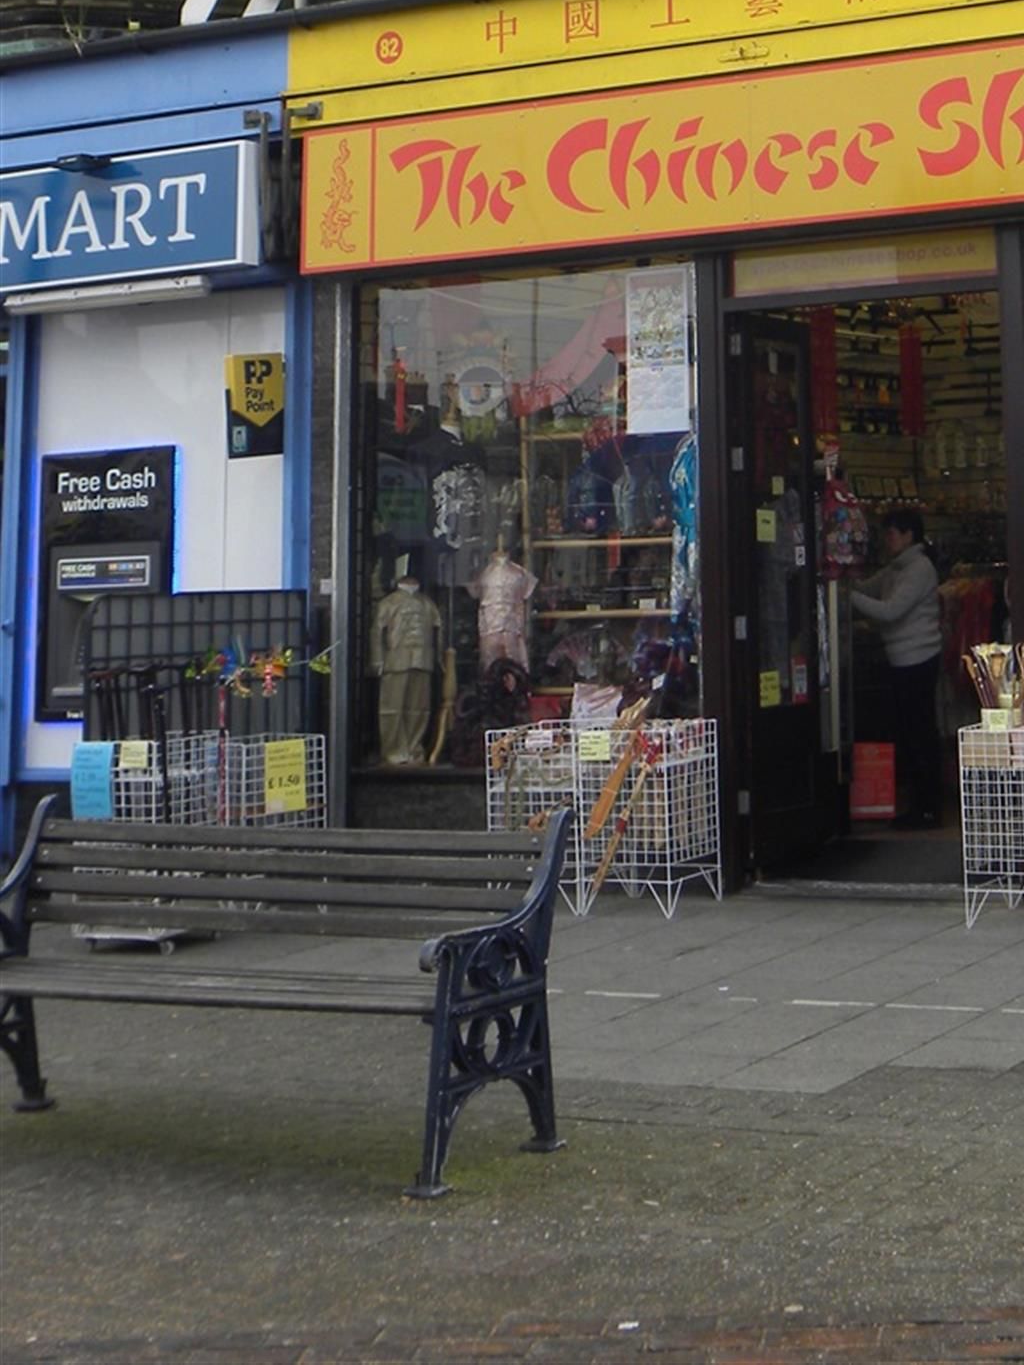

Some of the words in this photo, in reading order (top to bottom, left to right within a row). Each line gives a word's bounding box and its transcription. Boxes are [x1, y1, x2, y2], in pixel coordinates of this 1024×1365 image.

[378, 34, 399, 58] 82
[389, 139, 527, 232] The
[546, 116, 895, 215] Chinese
[0, 173, 207, 264] MART
[245, 386, 264, 402] Pay
[246, 399, 275, 413] Point
[57, 472, 101, 494] Free
[105, 467, 156, 491] Cash
[61, 492, 149, 513] withdrawals
